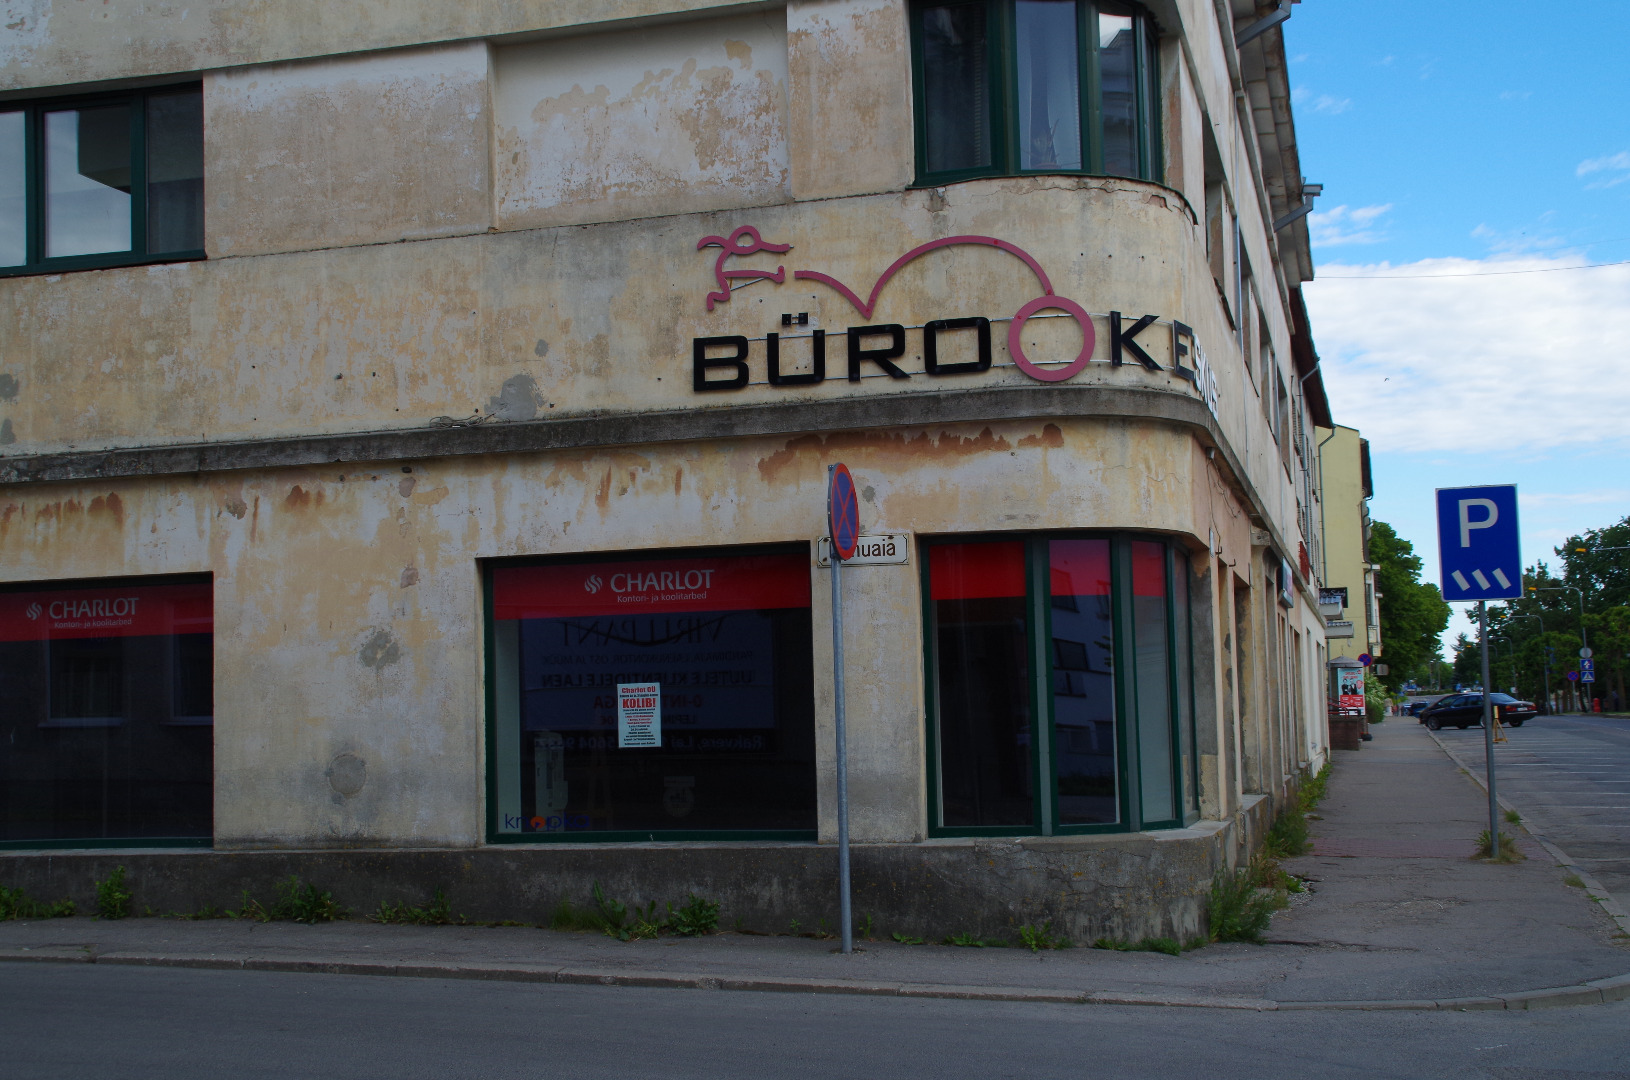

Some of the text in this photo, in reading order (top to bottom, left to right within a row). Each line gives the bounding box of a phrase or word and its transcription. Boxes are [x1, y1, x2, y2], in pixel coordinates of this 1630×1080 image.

[1458, 498, 1499, 548] P
[611, 569, 714, 593] CHARLOT
[49, 597, 140, 619] CHARLOT
[617, 591, 707, 603] Kontori- ja koolitarbed
[622, 697, 657, 709] KOLIB!
